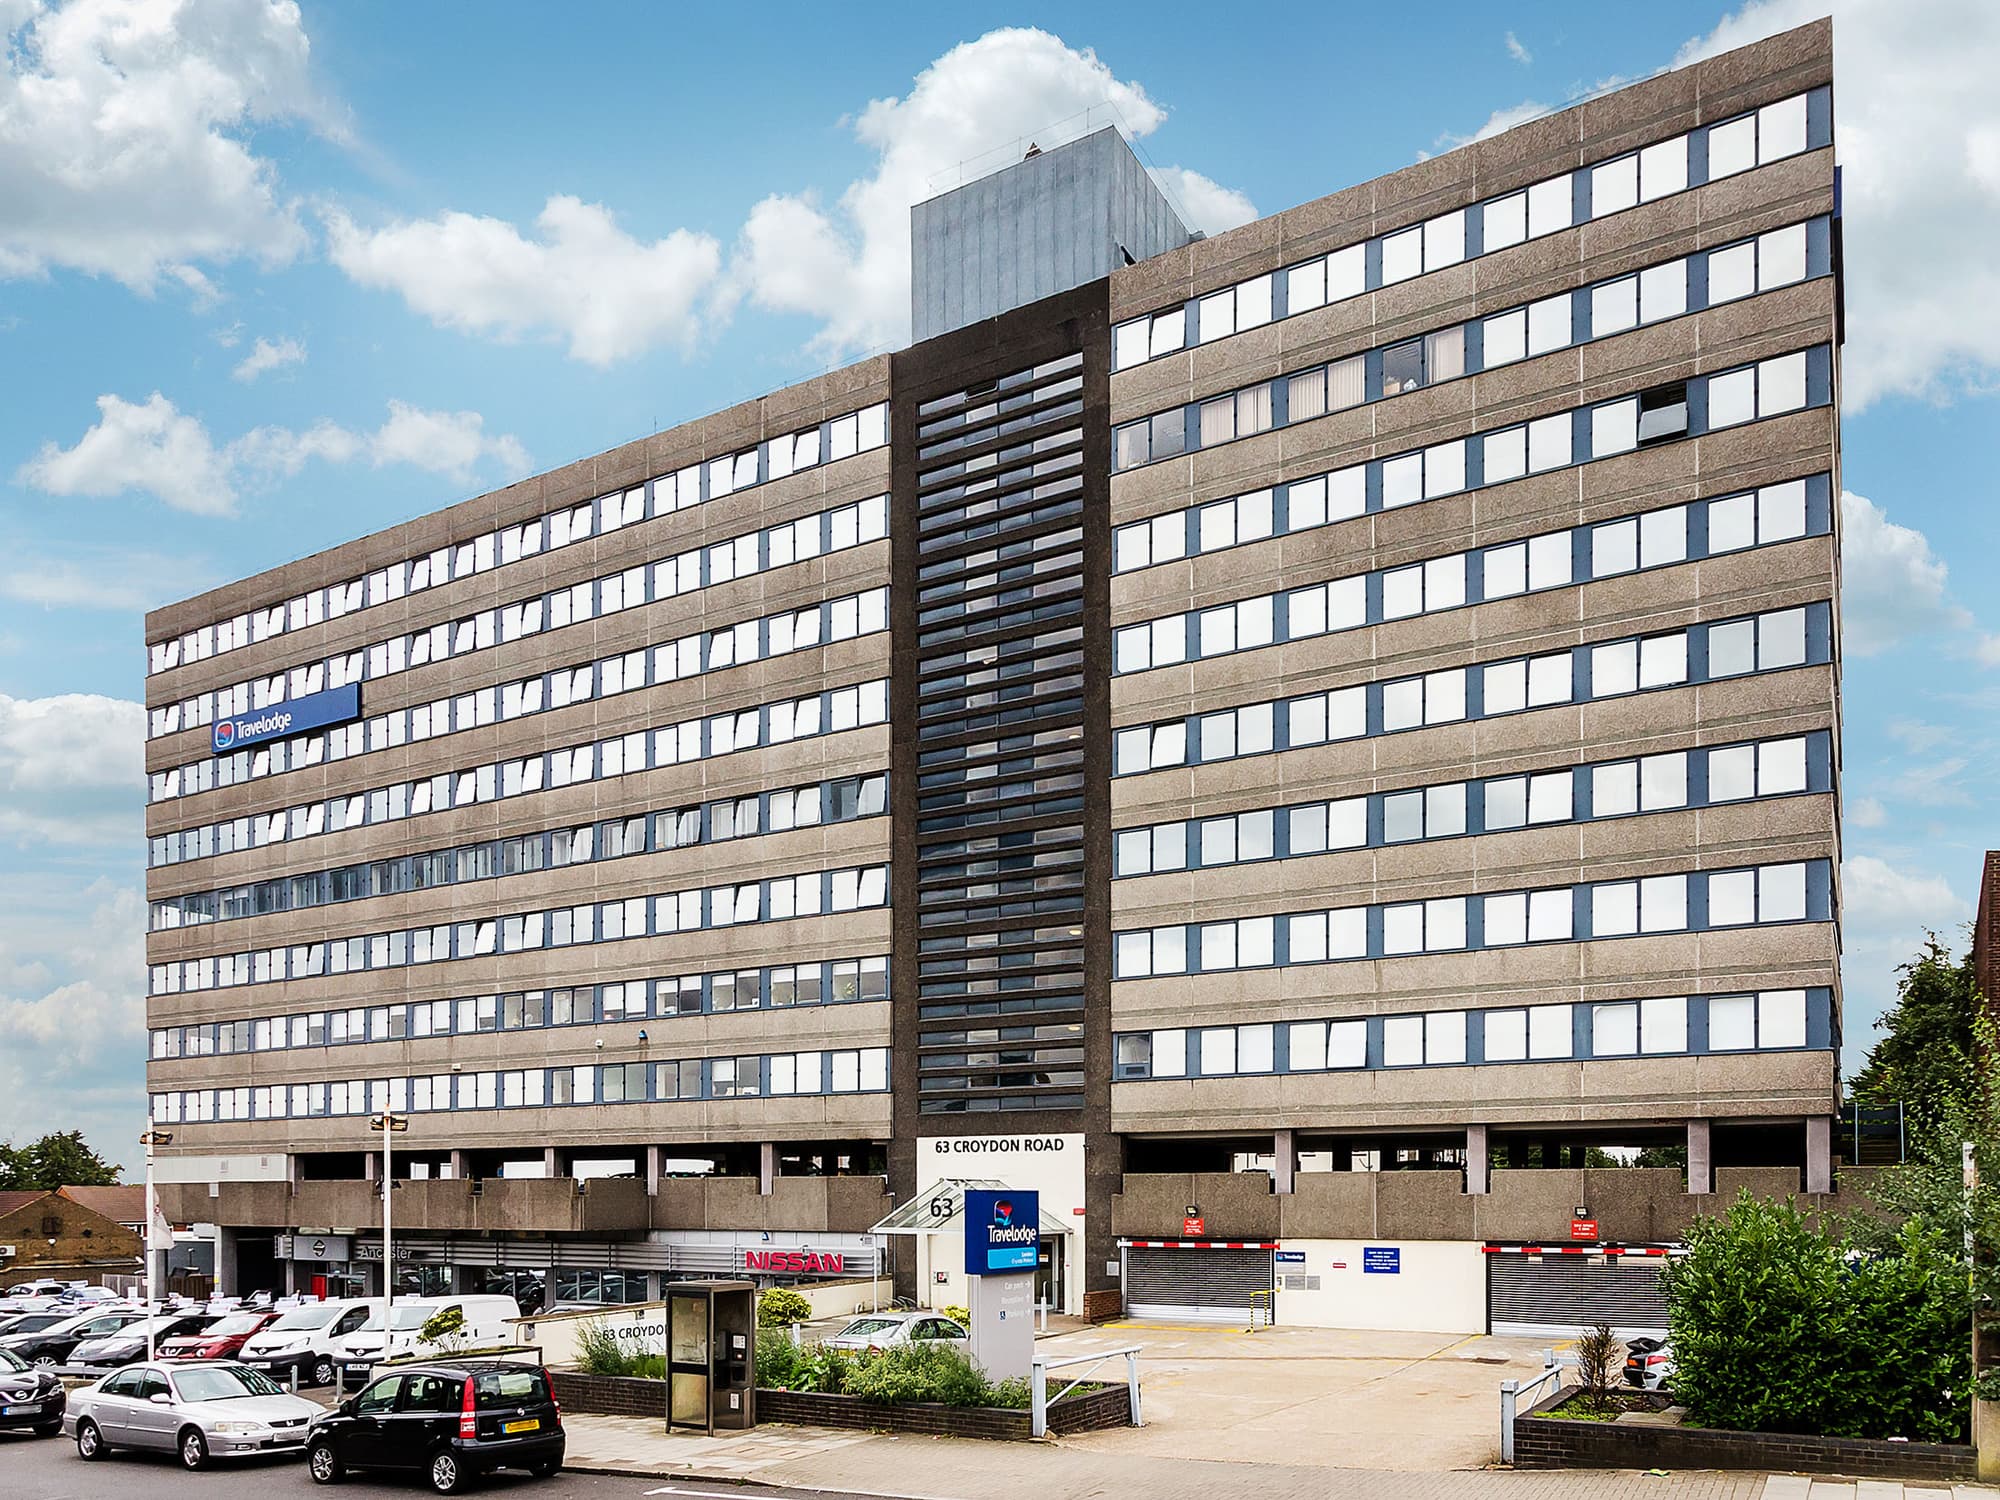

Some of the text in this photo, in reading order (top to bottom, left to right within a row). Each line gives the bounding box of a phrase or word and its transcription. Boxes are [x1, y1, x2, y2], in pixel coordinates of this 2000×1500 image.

[235, 711, 292, 739] Travelodge
[935, 1138, 1064, 1154] 63 CROYDON ROAD
[930, 1197, 953, 1218] 63
[987, 1224, 1037, 1245] Travelodge
[360, 1246, 412, 1259] Ancster
[745, 1251, 843, 1273] NISSAN
[602, 1323, 667, 1341] 63 CROYDO
